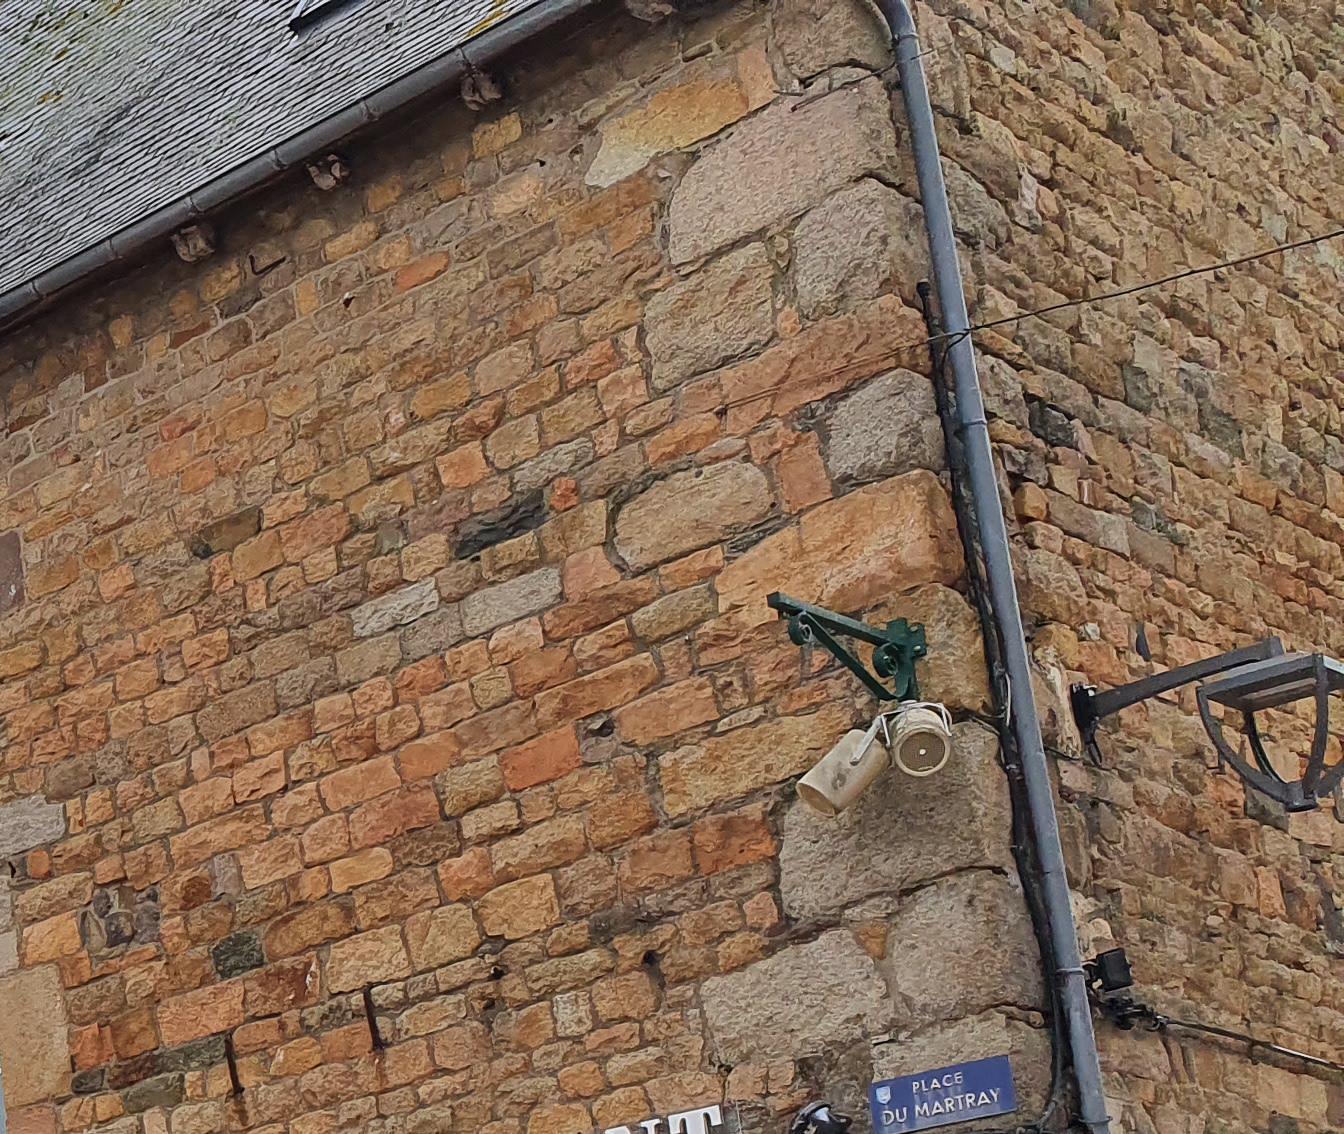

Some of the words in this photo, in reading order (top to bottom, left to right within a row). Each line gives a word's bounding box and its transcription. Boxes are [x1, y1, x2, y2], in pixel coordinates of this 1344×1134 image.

[912, 1071, 963, 1094] PLACE
[882, 1106, 907, 1126] DU
[915, 1087, 1000, 1118] MARTRAY
